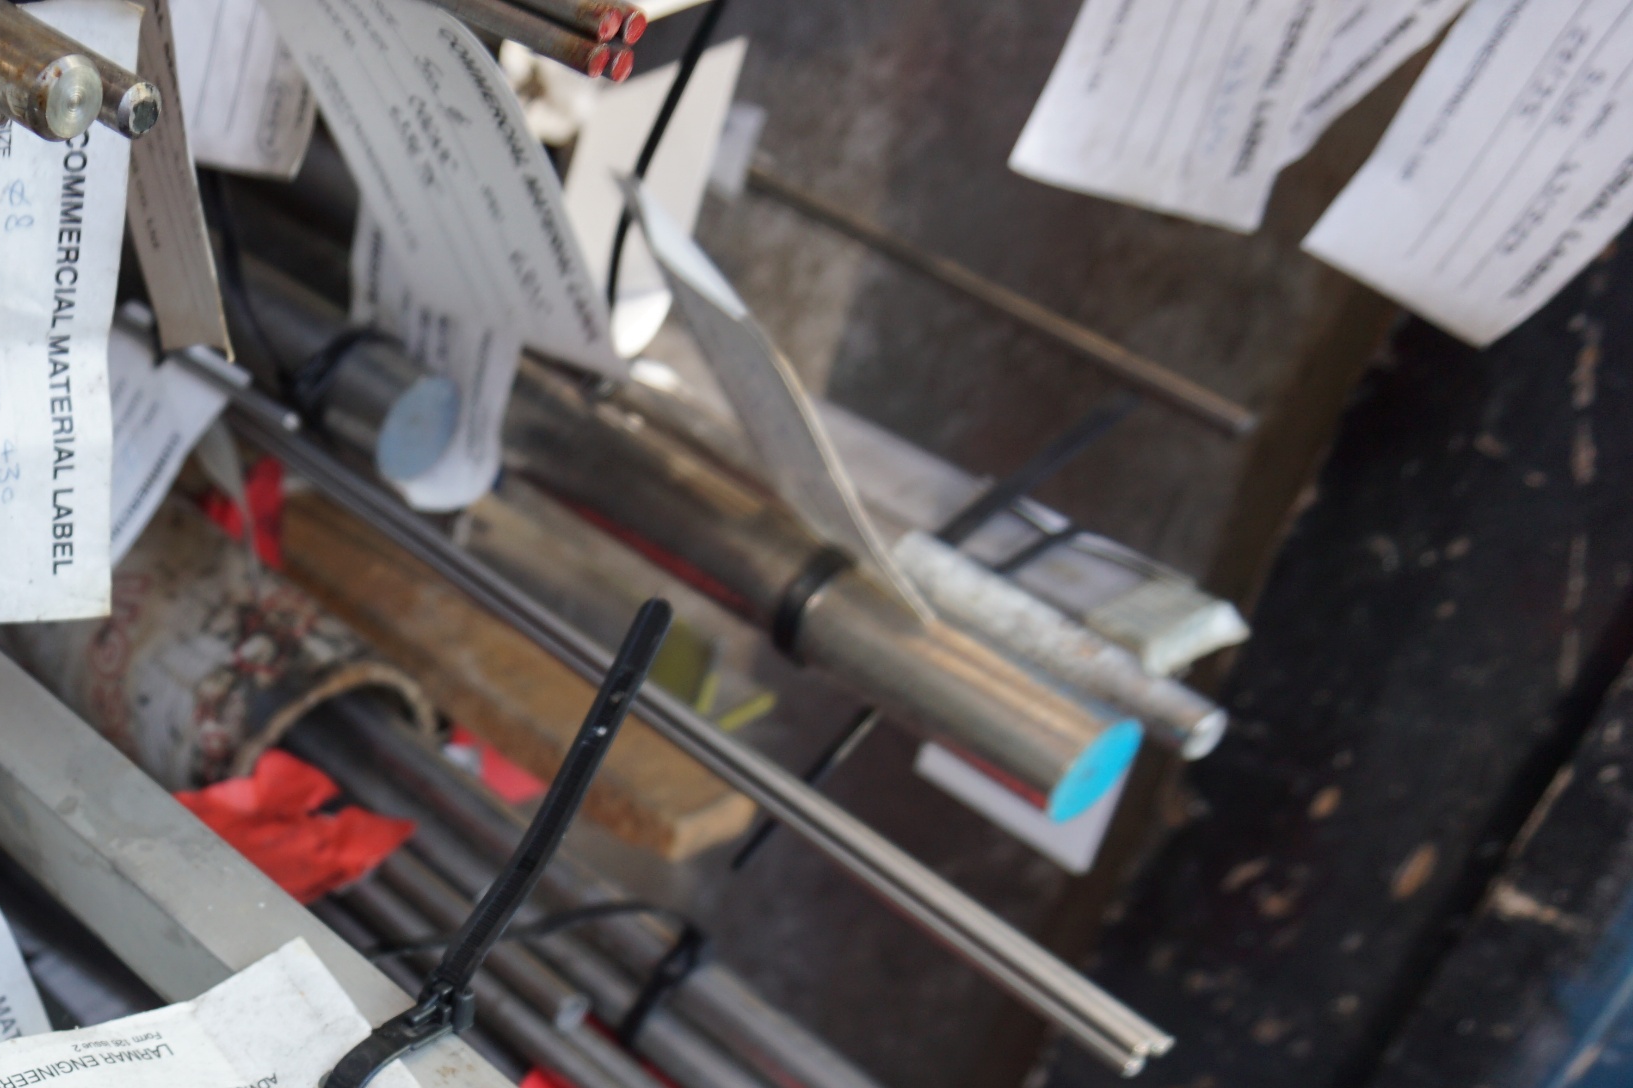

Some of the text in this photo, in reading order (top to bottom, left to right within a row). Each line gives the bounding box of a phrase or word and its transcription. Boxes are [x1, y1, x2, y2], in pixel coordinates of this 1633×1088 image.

[48, 334, 75, 481] MATERIAL
[52, 488, 74, 576] LABEL
[81, 1040, 111, 1049] issue
[131, 1031, 163, 1043] Form
[99, 1043, 174, 1064] LARMAR
